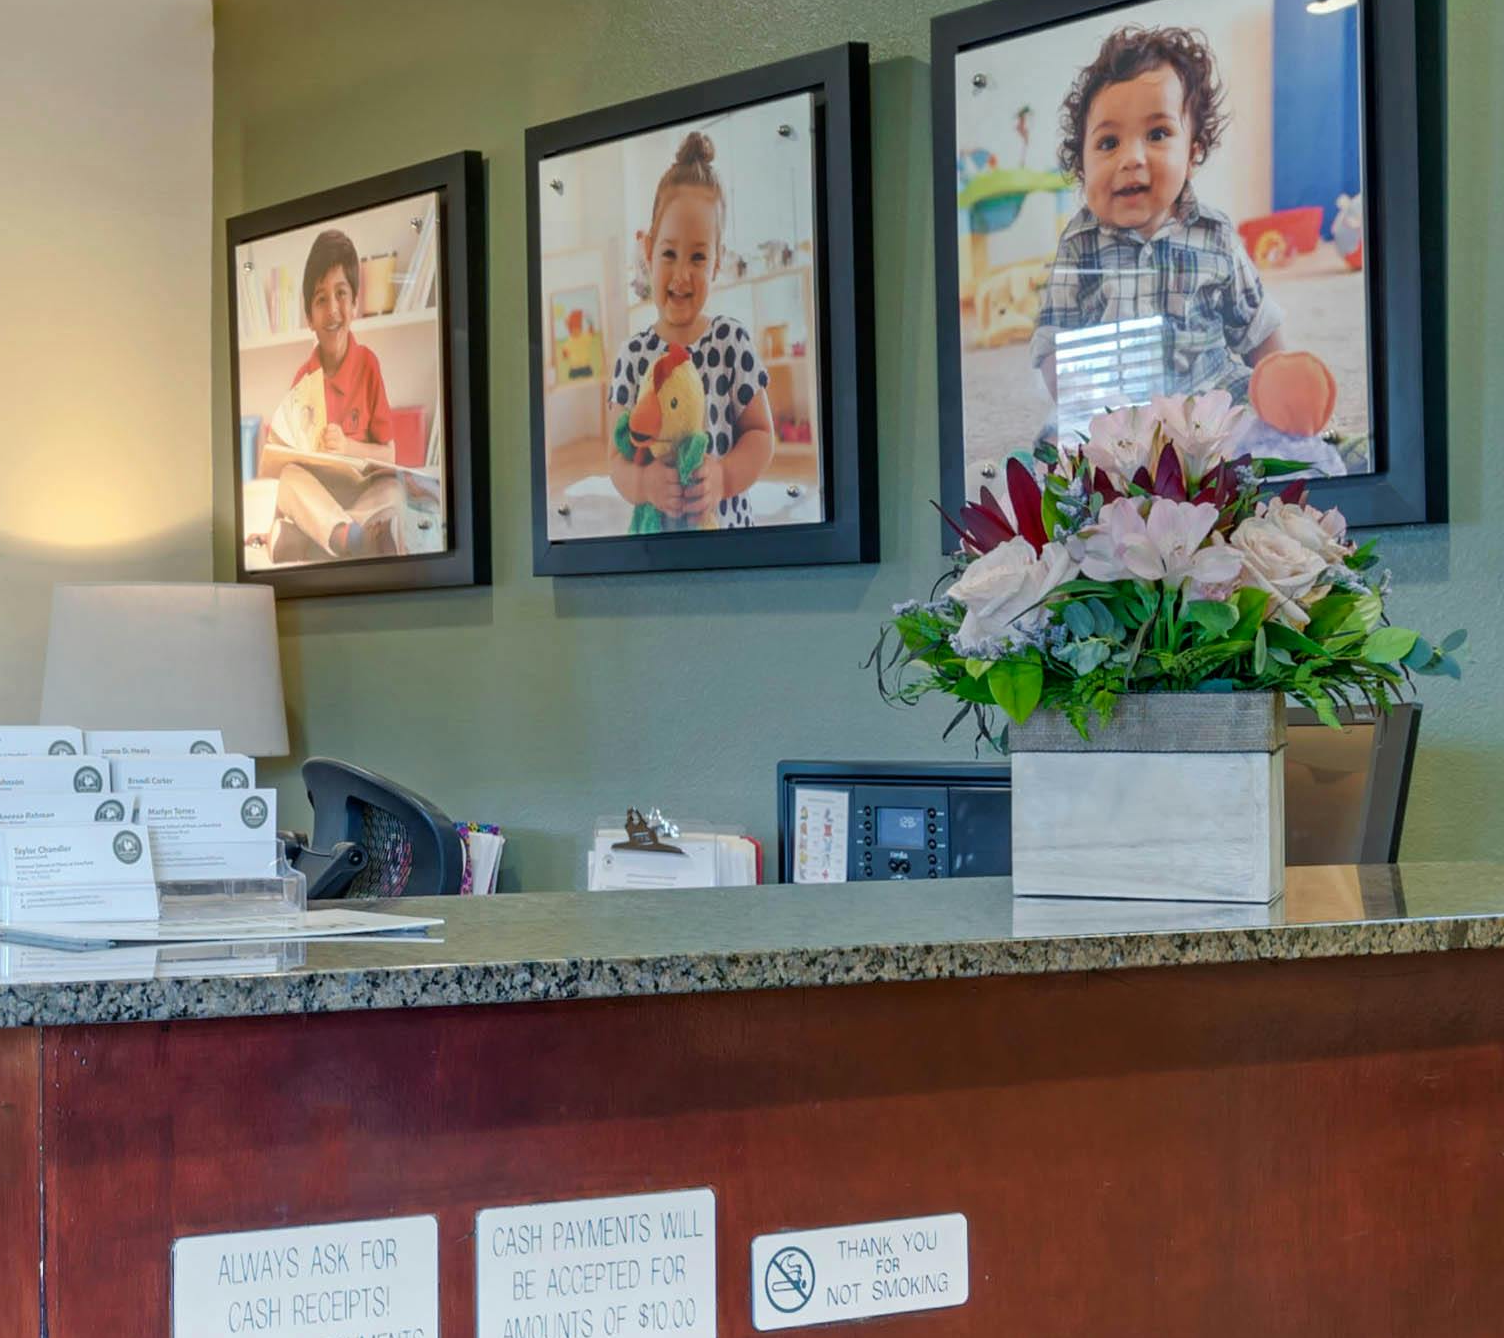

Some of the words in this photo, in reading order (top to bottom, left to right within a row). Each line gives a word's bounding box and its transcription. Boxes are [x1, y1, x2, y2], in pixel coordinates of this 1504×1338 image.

[492, 1223, 543, 1257] CASH
[553, 1213, 651, 1252] PAYMENTS
[660, 1209, 704, 1241] WILL
[838, 1236, 893, 1260] THANK
[902, 1231, 938, 1252] YOU
[218, 1246, 300, 1285] ALWAYS
[310, 1243, 350, 1277] ASK
[361, 1238, 398, 1272] FOR
[512, 1269, 537, 1301] BE
[547, 1260, 641, 1298] ACCEPTED
[651, 1255, 686, 1285] FOR
[876, 1257, 900, 1275] FOR
[228, 1298, 282, 1333] CASH
[293, 1286, 391, 1326] RECEIPTS!
[826, 1283, 862, 1307] NOT
[872, 1272, 949, 1301] SMOKING
[603, 1305, 628, 1336] OF
